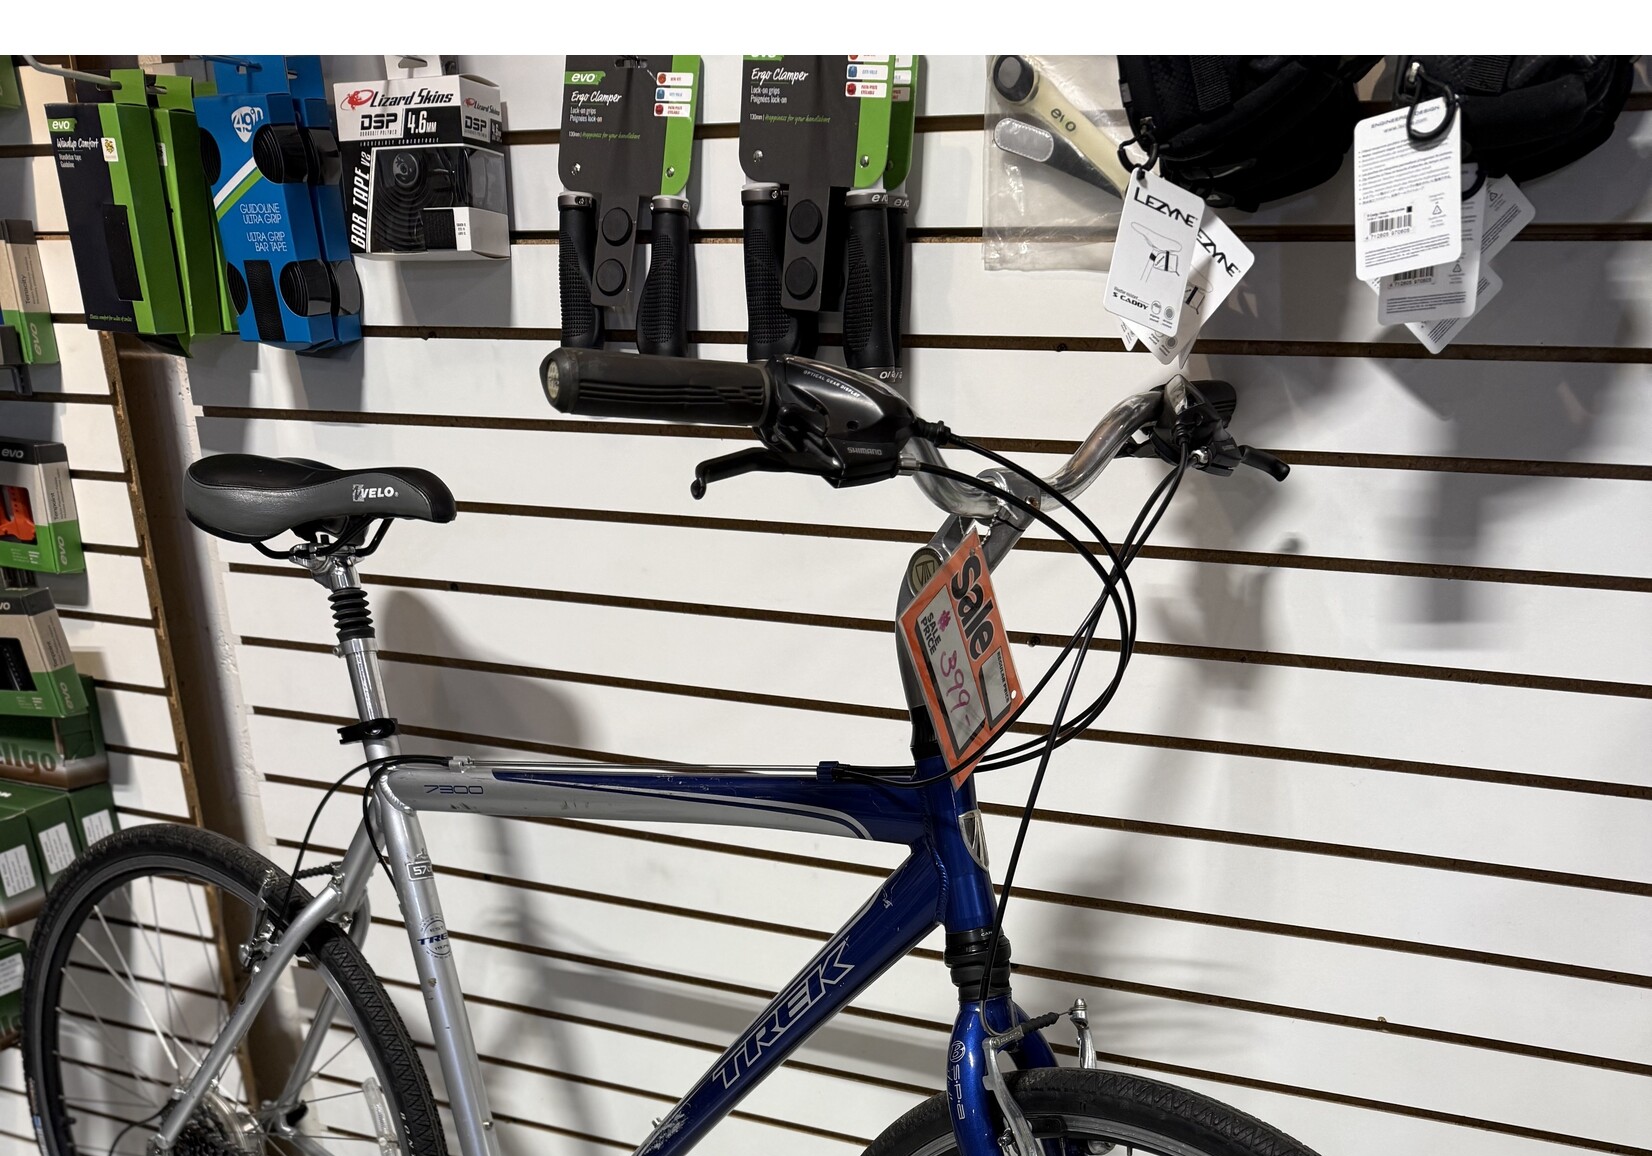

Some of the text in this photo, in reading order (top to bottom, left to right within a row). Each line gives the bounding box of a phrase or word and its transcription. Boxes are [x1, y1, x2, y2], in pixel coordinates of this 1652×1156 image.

[571, 73, 596, 83] evo
[751, 68, 809, 85] Ergo Clamper
[370, 88, 454, 108] Lizard Skins
[570, 90, 622, 106] Ergo Clamper
[52, 121, 70, 130] evo
[360, 112, 398, 130] DSP
[464, 115, 487, 131] DSP
[352, 167, 371, 210] TAPE
[240, 203, 281, 214] GUIDOLINE
[1134, 186, 1195, 228] LEZYNE
[243, 214, 282, 225] ULTRA GRIP
[247, 231, 285, 242] ULTRA GRIP
[350, 212, 368, 250] BAR
[254, 242, 288, 252] BAR TAPE
[1196, 228, 1239, 278] EZYNE
[1120, 294, 1149, 310] CADDY
[30, 322, 42, 356] evo
[826, 378, 840, 387] GEAR
[840, 384, 861, 398] DISPLAY
[1, 448, 24, 459] evo
[848, 447, 883, 456] SHIMANO
[361, 486, 394, 499] VELO
[57, 535, 68, 565] evo
[951, 555, 995, 661] Sale
[921, 616, 937, 656] PRICE
[927, 612, 941, 645] SALE
[996, 650, 1006, 682] REGULAR
[424, 785, 483, 794] 7300
[417, 932, 448, 945] TRE
[712, 939, 855, 1089] TREK
